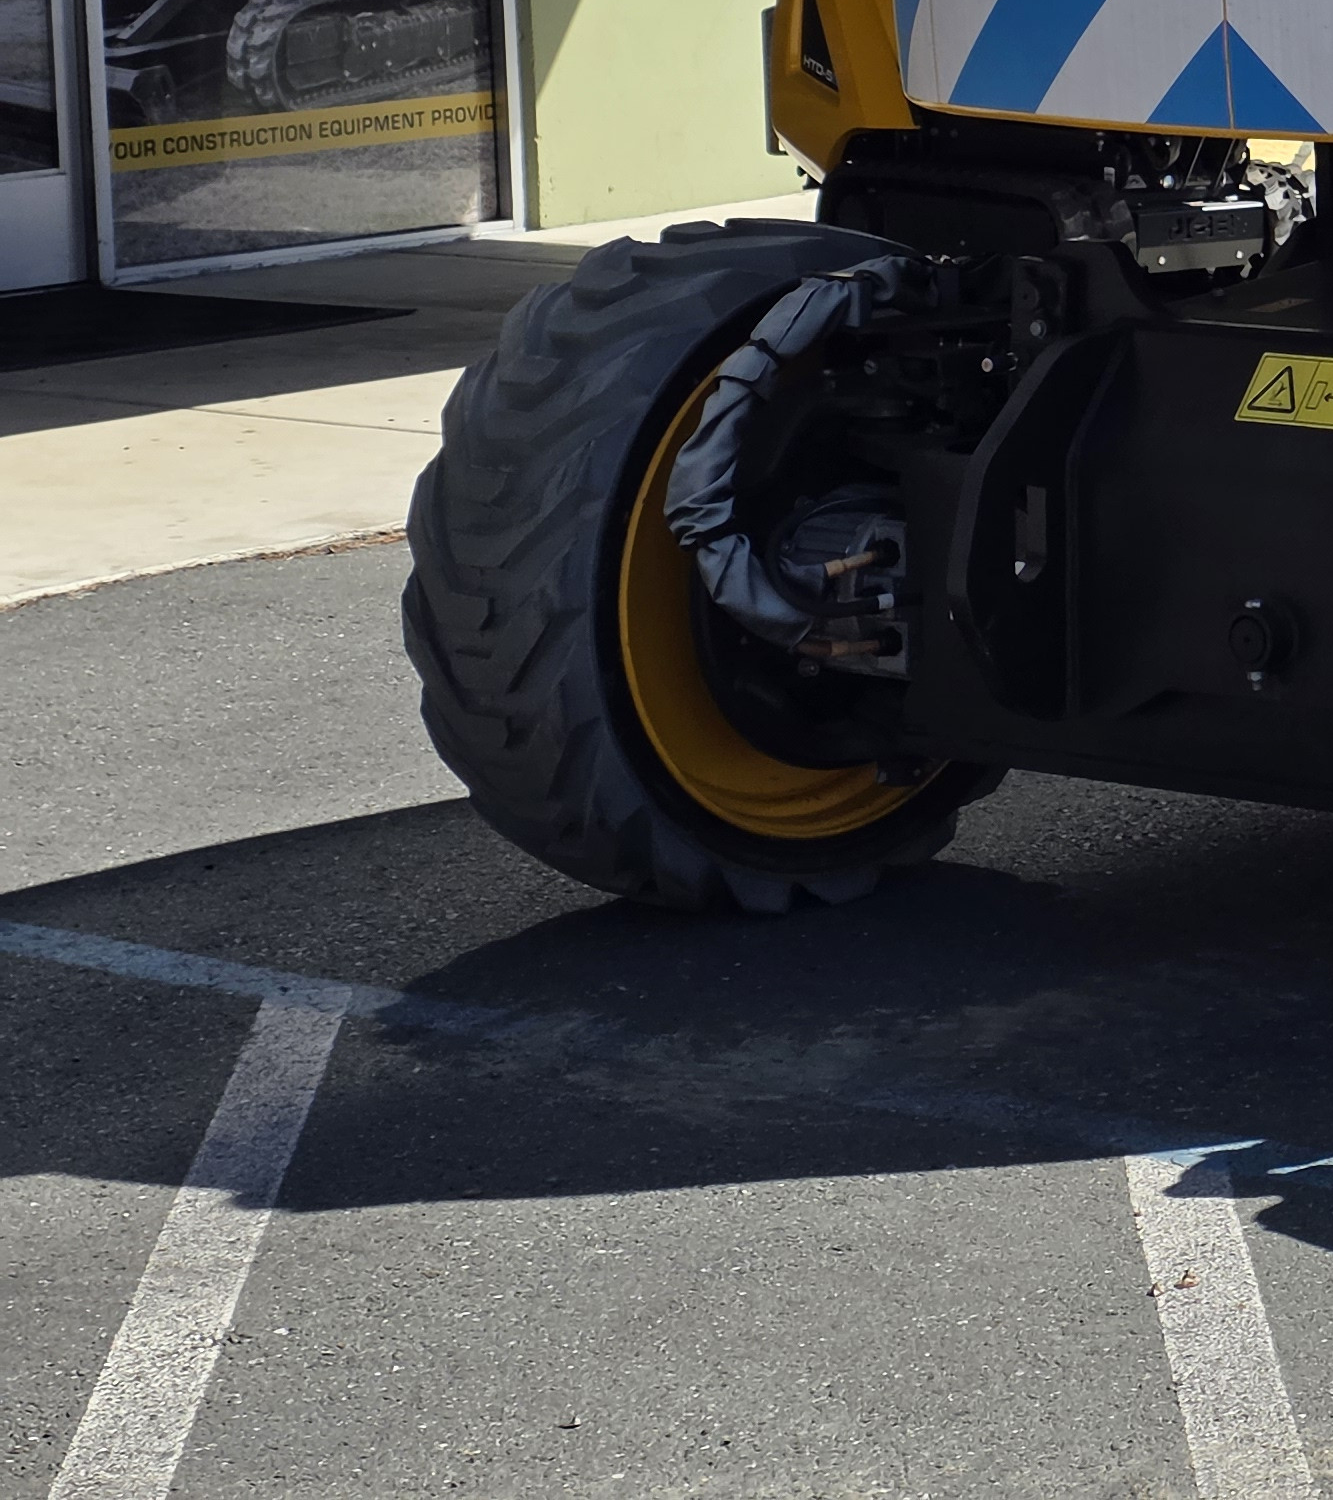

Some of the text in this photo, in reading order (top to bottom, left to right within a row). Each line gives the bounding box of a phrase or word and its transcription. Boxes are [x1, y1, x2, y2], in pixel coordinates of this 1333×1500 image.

[109, 139, 156, 160] OUR
[163, 123, 312, 155] CONSTRUCTION
[318, 111, 425, 139] EQUIPMENT
